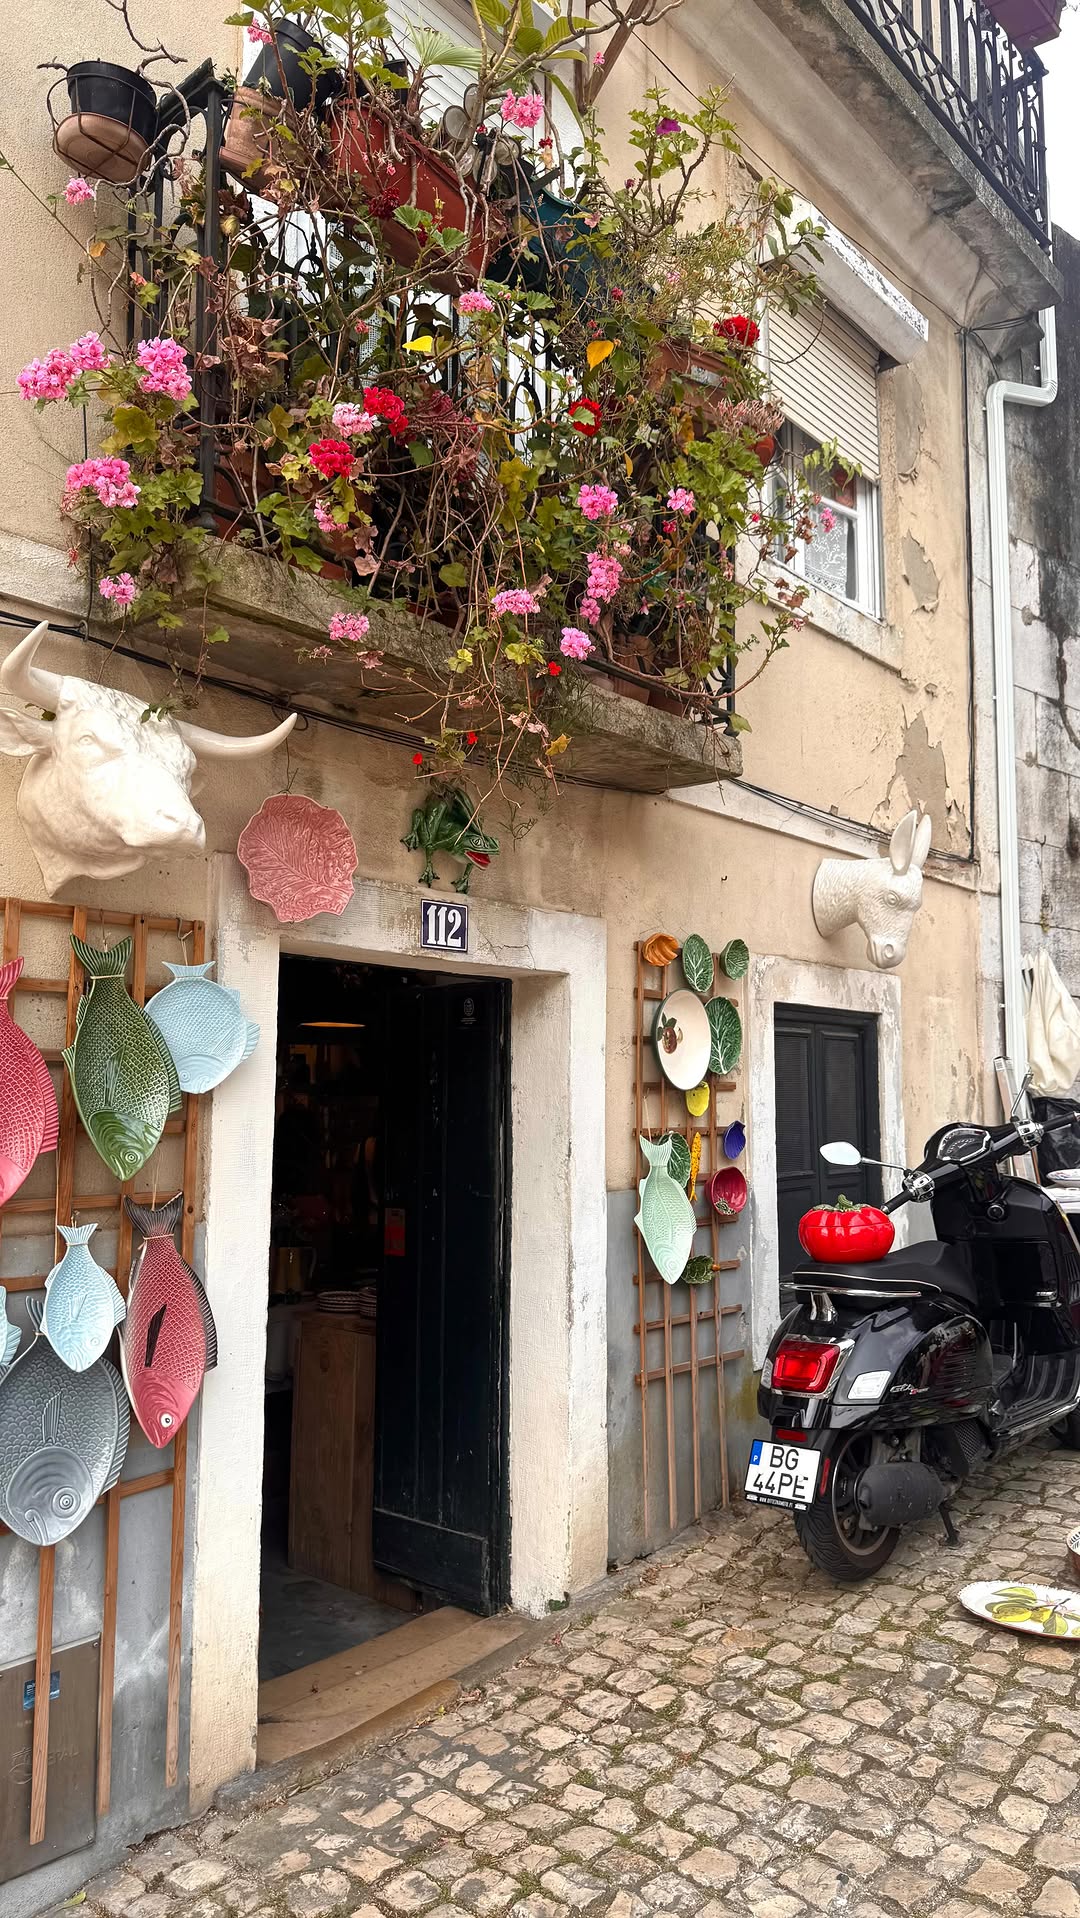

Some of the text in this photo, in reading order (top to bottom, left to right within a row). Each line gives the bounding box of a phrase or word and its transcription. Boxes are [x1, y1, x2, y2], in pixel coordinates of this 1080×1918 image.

[427, 905, 462, 948] 112
[769, 1445, 799, 1470] BG
[753, 1471, 809, 1499] 44PE
